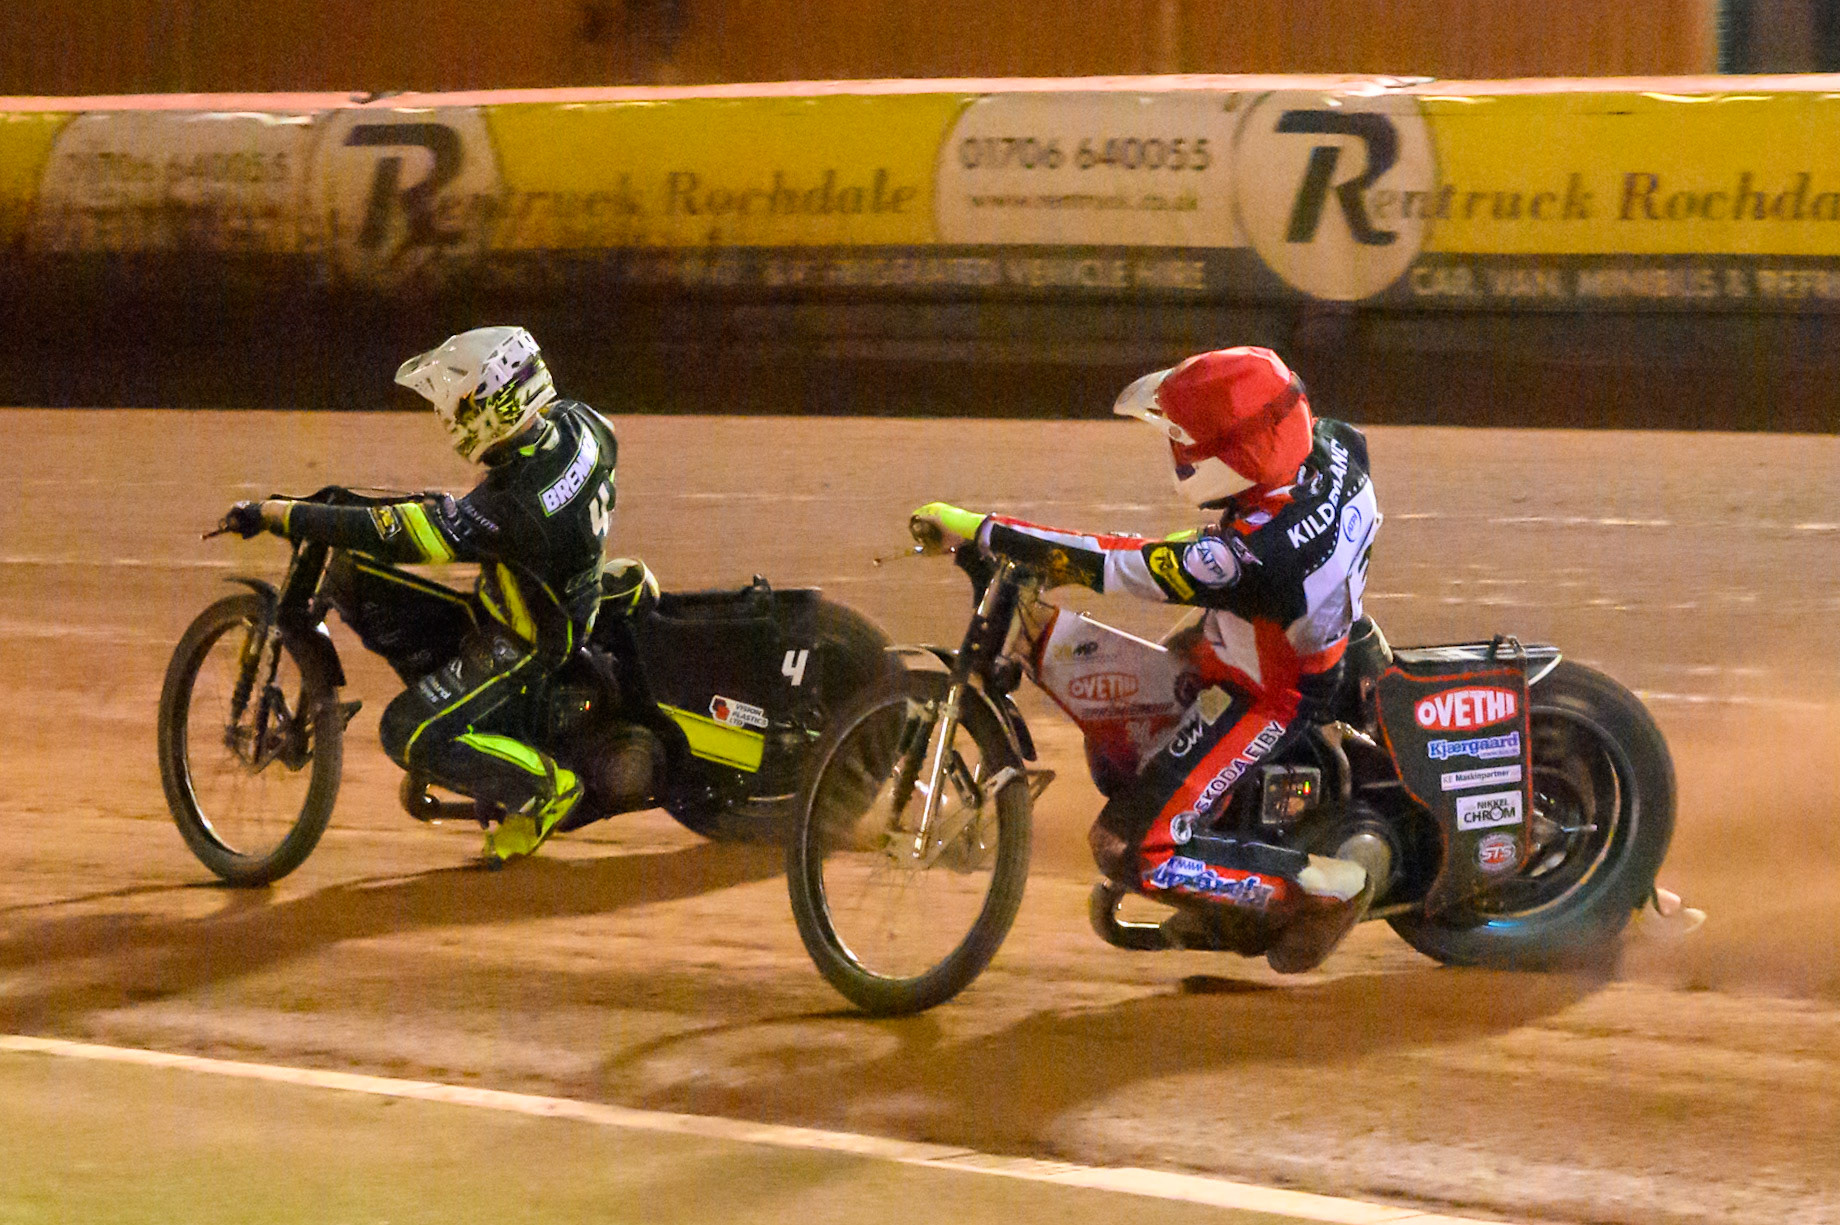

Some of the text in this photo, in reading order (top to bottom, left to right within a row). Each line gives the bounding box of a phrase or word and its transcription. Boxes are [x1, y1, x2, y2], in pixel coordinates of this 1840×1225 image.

[960, 138, 1213, 172] 01706 640055
[781, 649, 810, 686] 4
[735, 702, 763, 715] VISION
[1416, 689, 1515, 728] OVETHI
[731, 710, 768, 726] PLASTICS
[1195, 759, 1246, 810] SKODA
[1454, 769, 1510, 783] Maskinpartner
[1477, 798, 1508, 810] NIKKEL
[1463, 805, 1516, 822] CHROM
